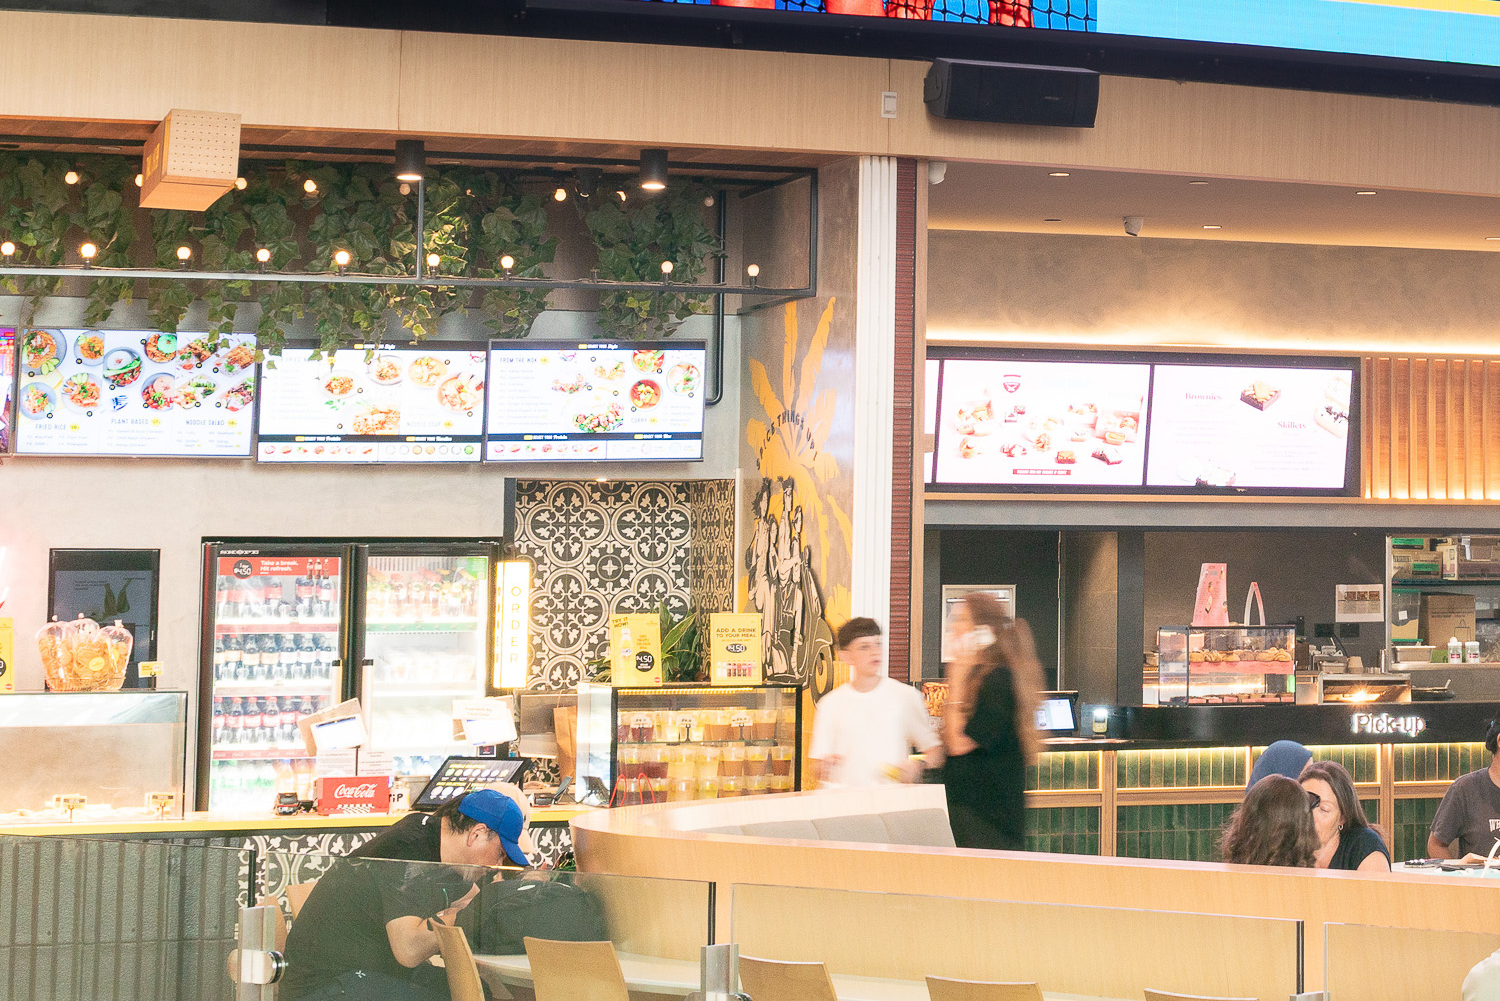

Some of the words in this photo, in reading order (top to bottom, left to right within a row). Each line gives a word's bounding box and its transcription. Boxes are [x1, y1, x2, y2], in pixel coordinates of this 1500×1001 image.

[1185, 392, 1222, 401] Brownies
[1277, 421, 1307, 430] Skillets
[756, 421, 775, 470] SPICE
[777, 409, 805, 431] THINGS
[510, 586, 522, 664] ORDER
[1352, 713, 1426, 737] Pick-up
[334, 784, 378, 799] Coca-Cola
